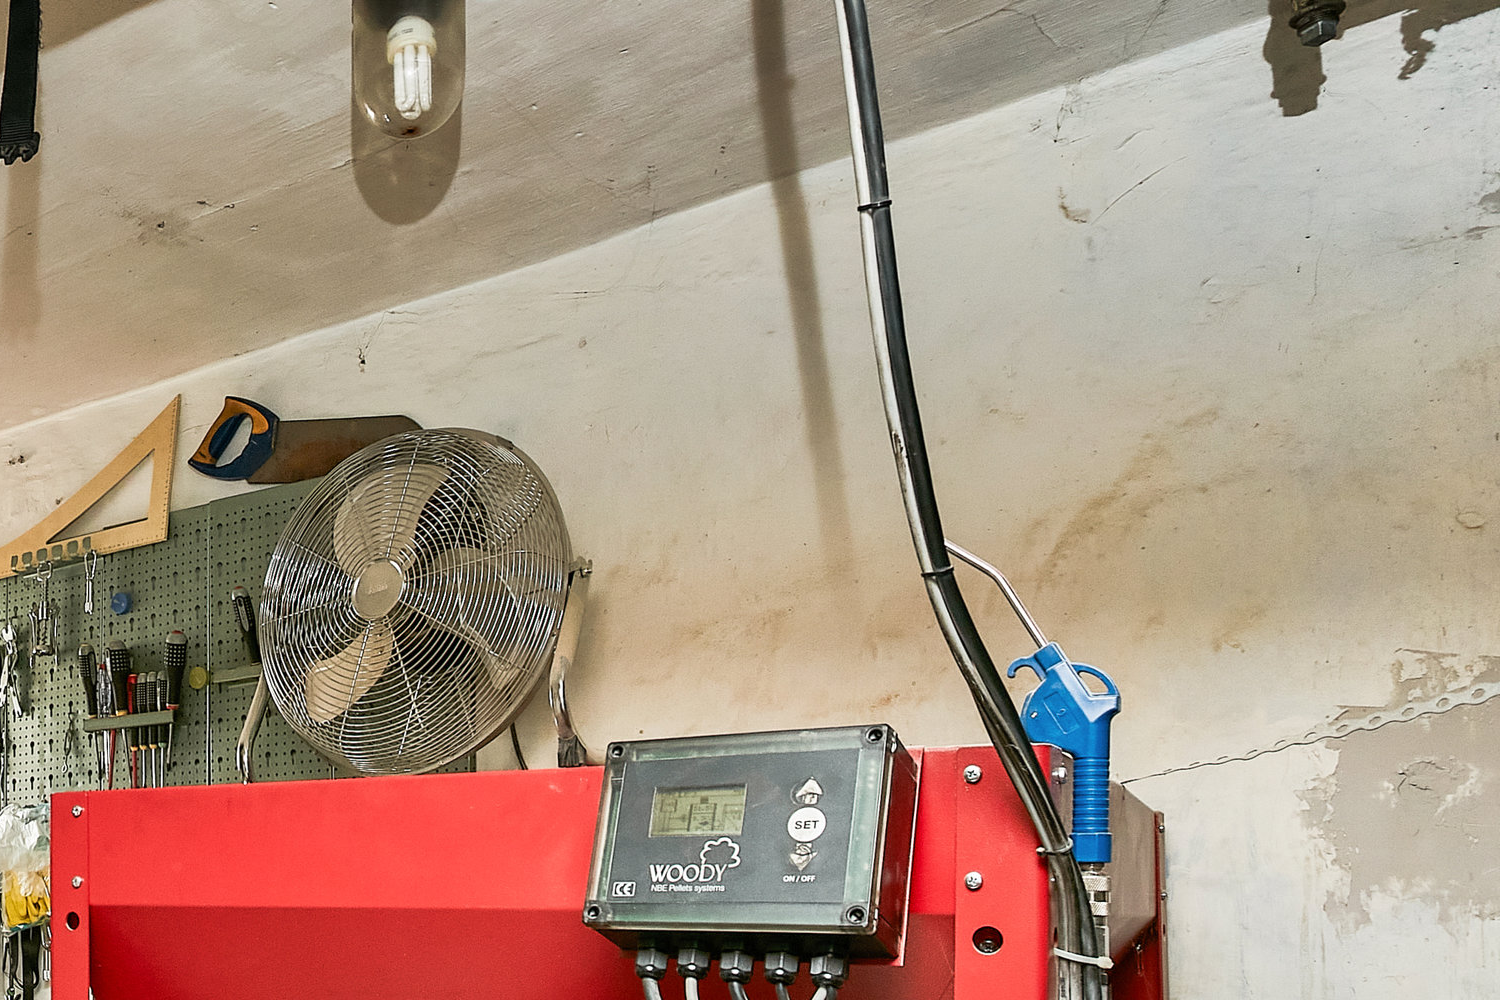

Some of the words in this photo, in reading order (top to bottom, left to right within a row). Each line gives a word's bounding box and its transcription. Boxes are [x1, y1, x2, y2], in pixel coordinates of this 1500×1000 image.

[794, 820, 819, 830] SET
[650, 864, 727, 882] WOODY
[651, 884, 667, 892] NBE
[669, 884, 693, 892] Pellets
[694, 884, 725, 893] systems
